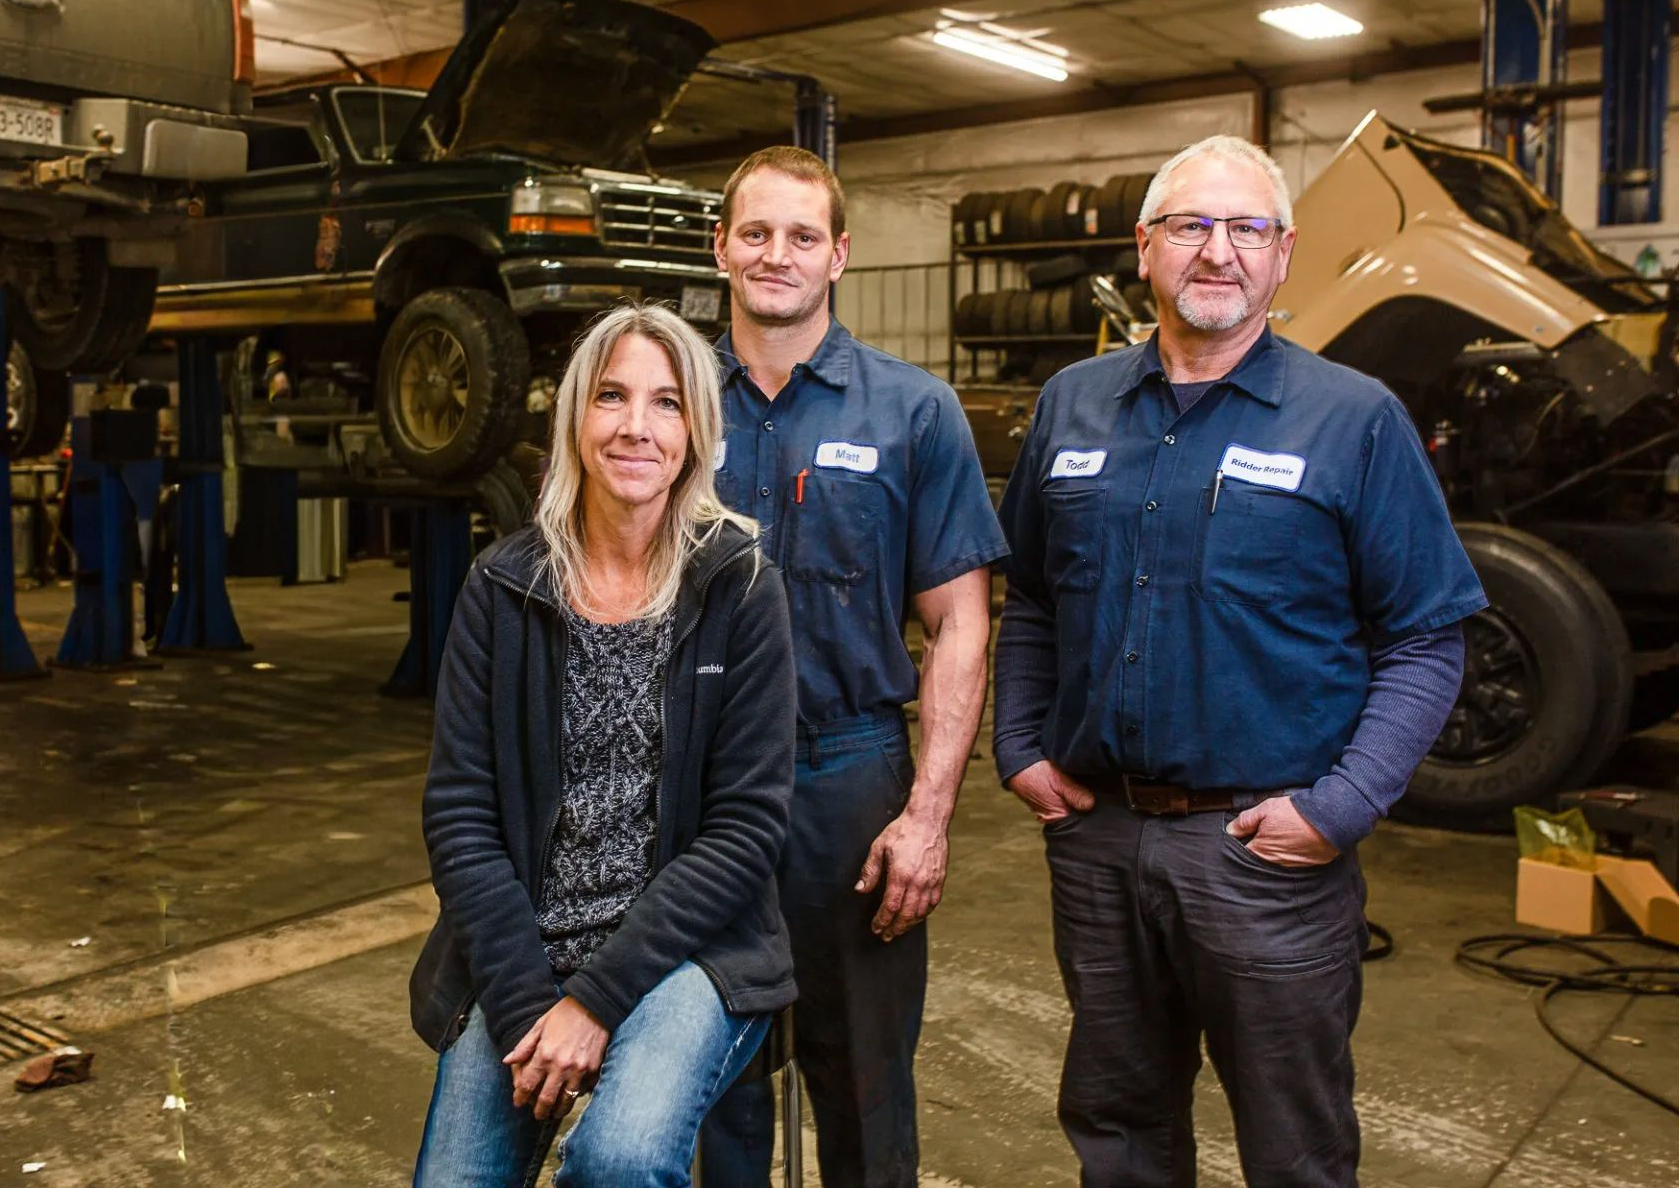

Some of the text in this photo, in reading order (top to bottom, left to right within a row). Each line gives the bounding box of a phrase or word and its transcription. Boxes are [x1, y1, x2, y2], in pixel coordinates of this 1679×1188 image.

[835, 449, 860, 463] Matt
[1065, 459, 1091, 471] Todd
[1231, 458, 1294, 476] Ridder Repair
[696, 663, 724, 674] umbia
